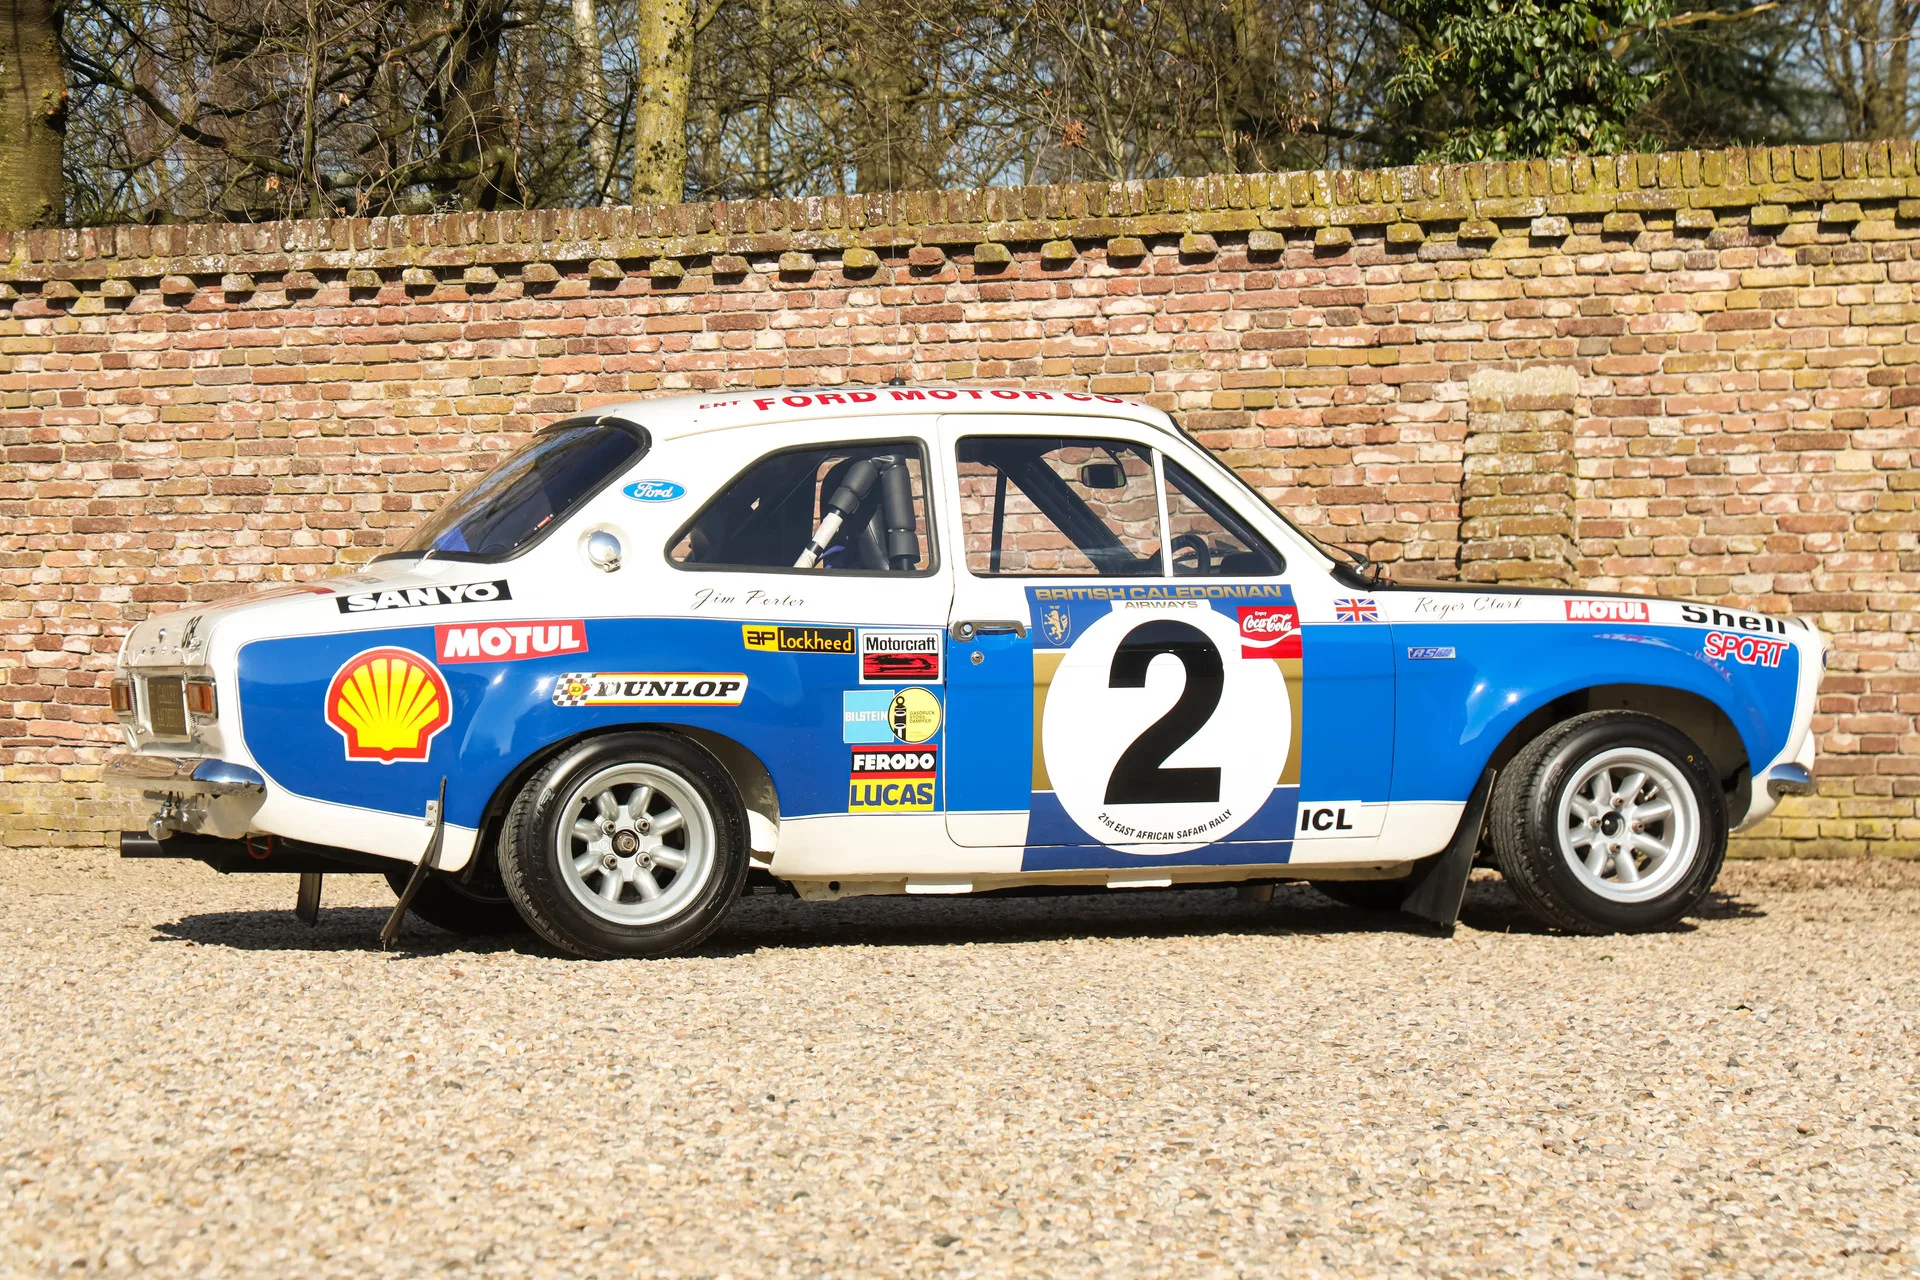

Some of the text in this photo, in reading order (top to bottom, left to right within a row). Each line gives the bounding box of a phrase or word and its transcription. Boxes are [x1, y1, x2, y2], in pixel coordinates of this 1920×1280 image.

[753, 391, 877, 411] FORD
[890, 389, 1053, 401] MOTOR
[1063, 392, 1139, 407] CO.
[634, 482, 674, 499] Ford
[347, 581, 500, 612] SANYO
[691, 588, 805, 611] Jim Porter
[1035, 585, 1282, 601] BRITISH CALEDONIAN
[1124, 600, 1199, 609] AIRWAYS
[1414, 596, 1523, 620] Roger Clark
[1569, 601, 1648, 621] MOTUL
[1681, 604, 1786, 635] Shell
[443, 624, 581, 659] MOTUL
[866, 636, 936, 651] Motorcraft
[1705, 632, 1788, 666] SPORT
[594, 681, 741, 697] DUNLOP
[844, 711, 888, 722] BILSTEIN
[1104, 619, 1225, 805] 2
[852, 752, 935, 771] FERODO
[849, 782, 934, 807] LUCAS
[1097, 808, 1232, 841] 21st EAST AFRICAN SAFARI RALLY
[1300, 808, 1353, 831] ICL
